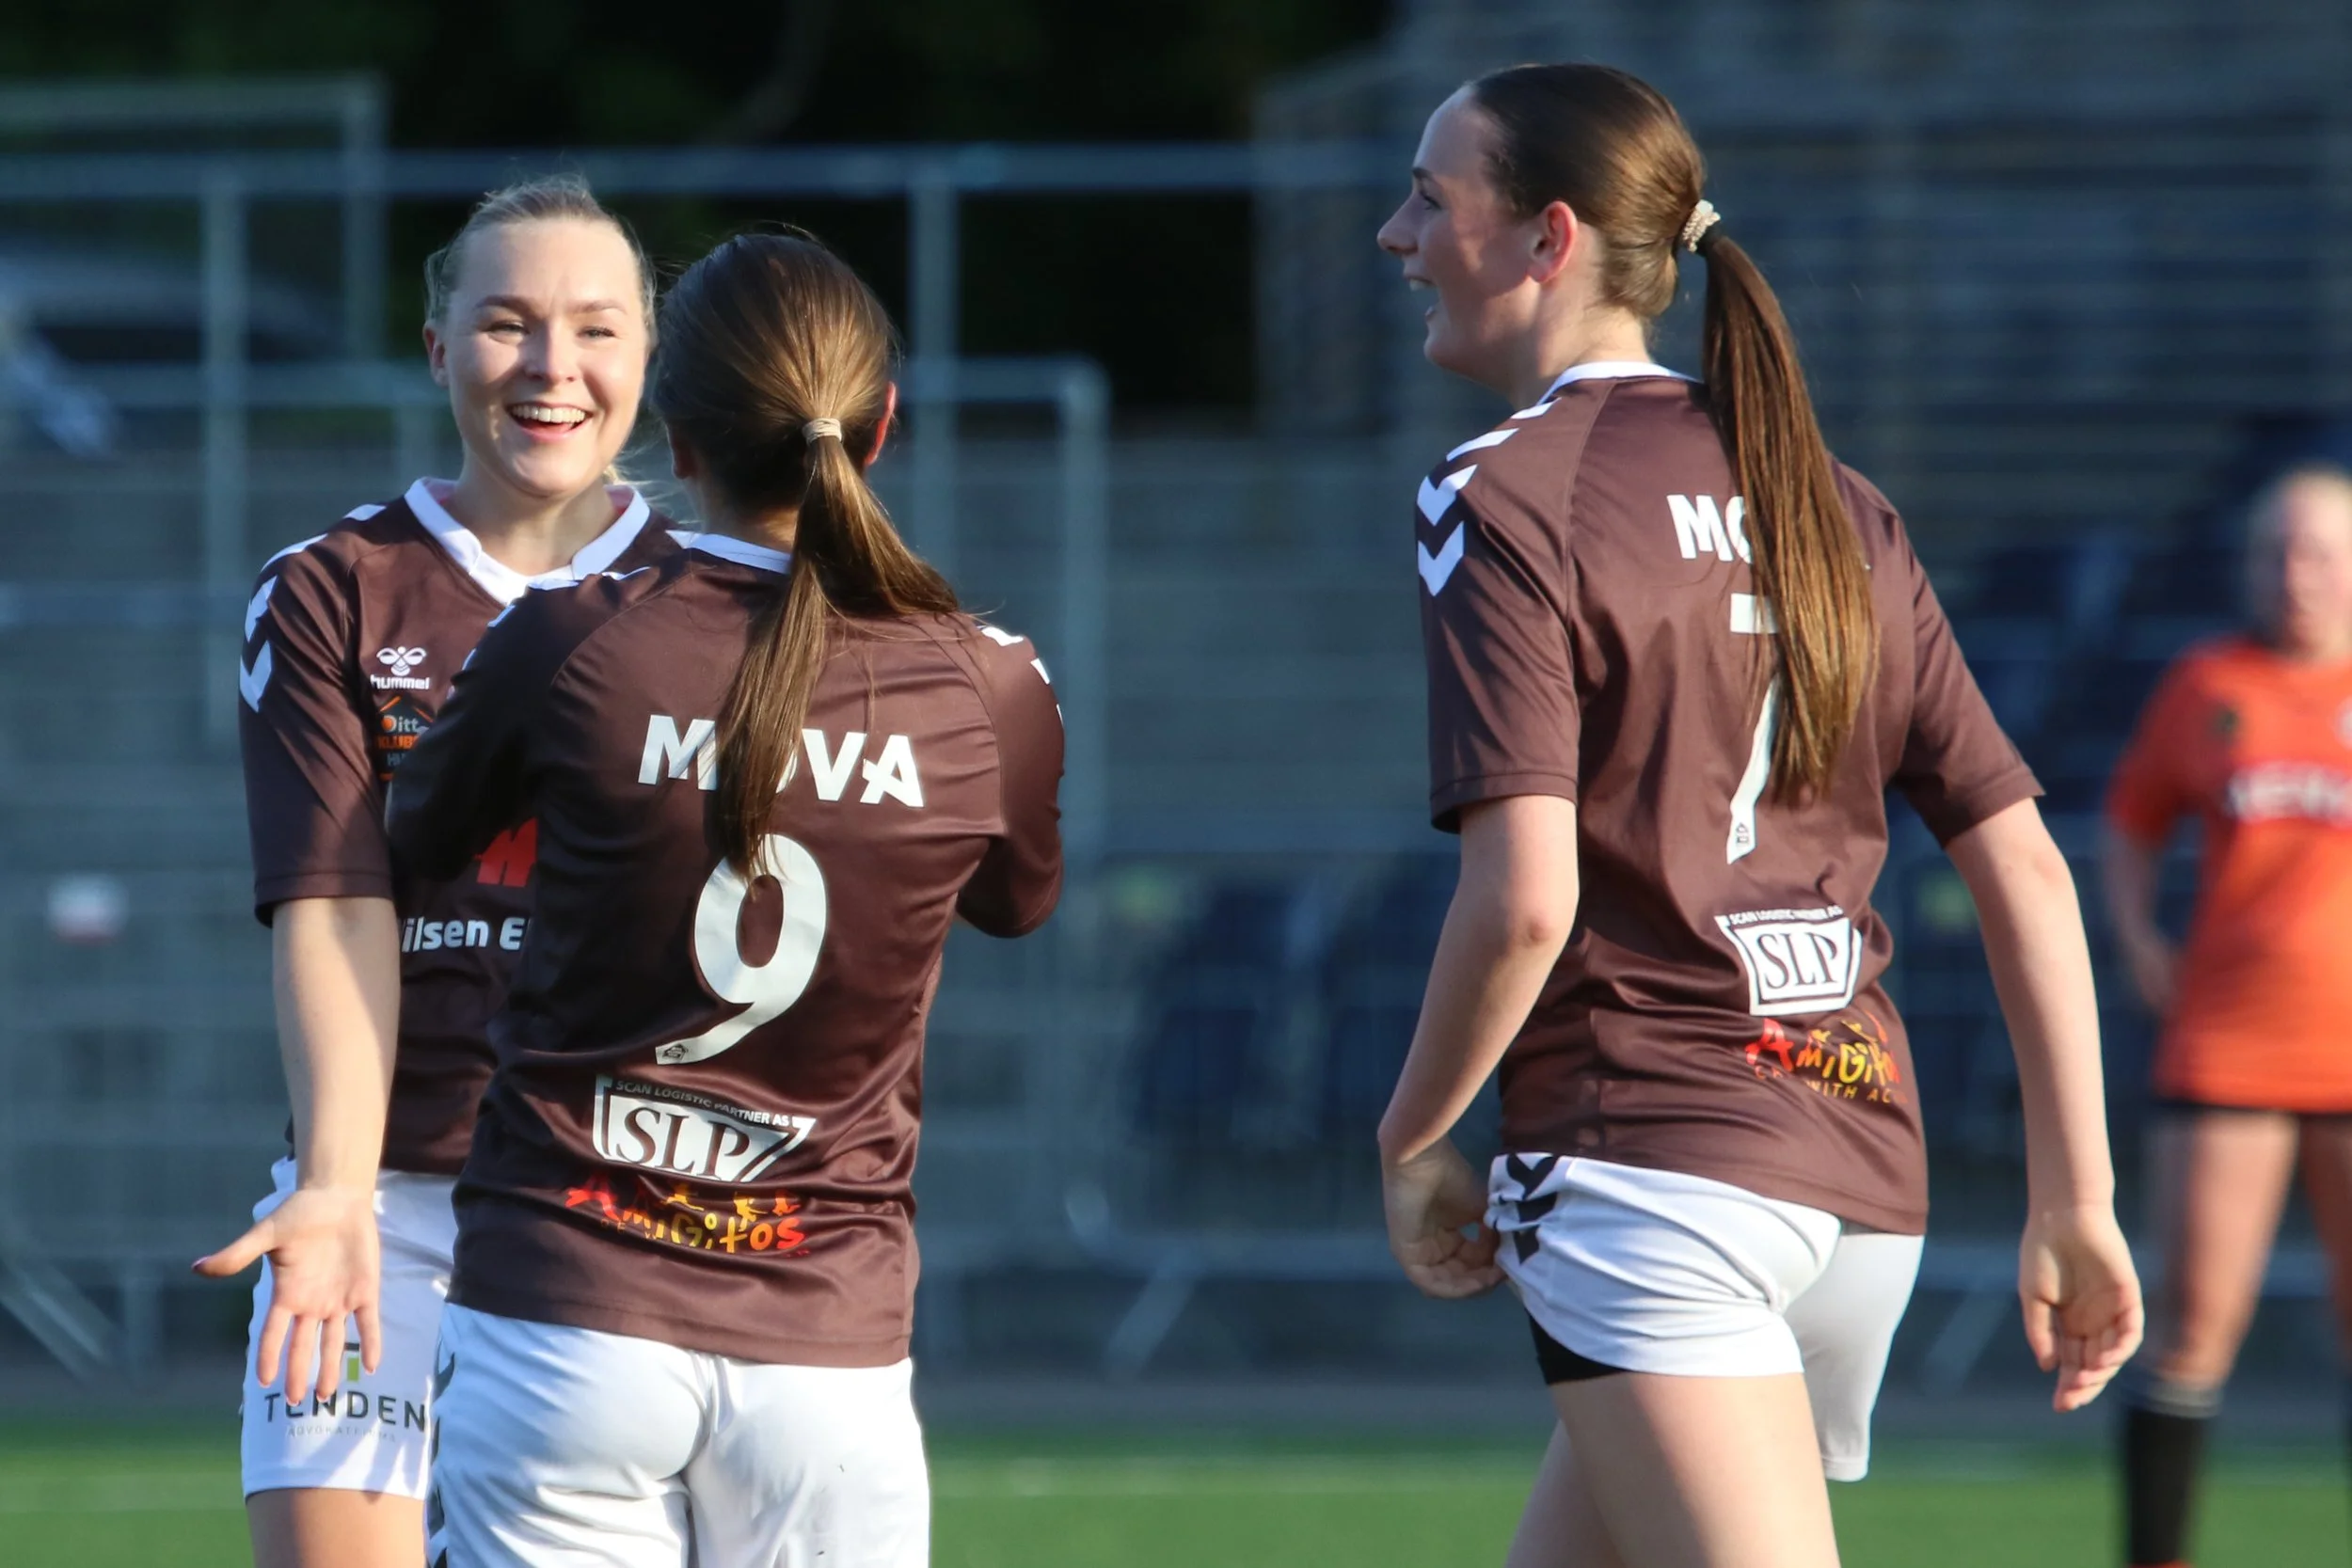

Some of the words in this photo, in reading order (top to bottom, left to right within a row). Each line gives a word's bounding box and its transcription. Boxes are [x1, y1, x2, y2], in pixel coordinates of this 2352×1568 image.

[370, 674, 430, 689] hummel
[377, 736, 420, 750] KLUB
[1726, 593, 1780, 864] 7
[402, 916, 489, 952] ilsen
[655, 833, 827, 1065] 9
[1756, 932, 1838, 990] SLP
[615, 1081, 651, 1096] SCAN
[654, 1088, 712, 1109] LOGISTIC
[713, 1102, 770, 1125] PARTNER
[772, 1114, 791, 1127] AS
[615, 1107, 750, 1181] SLP
